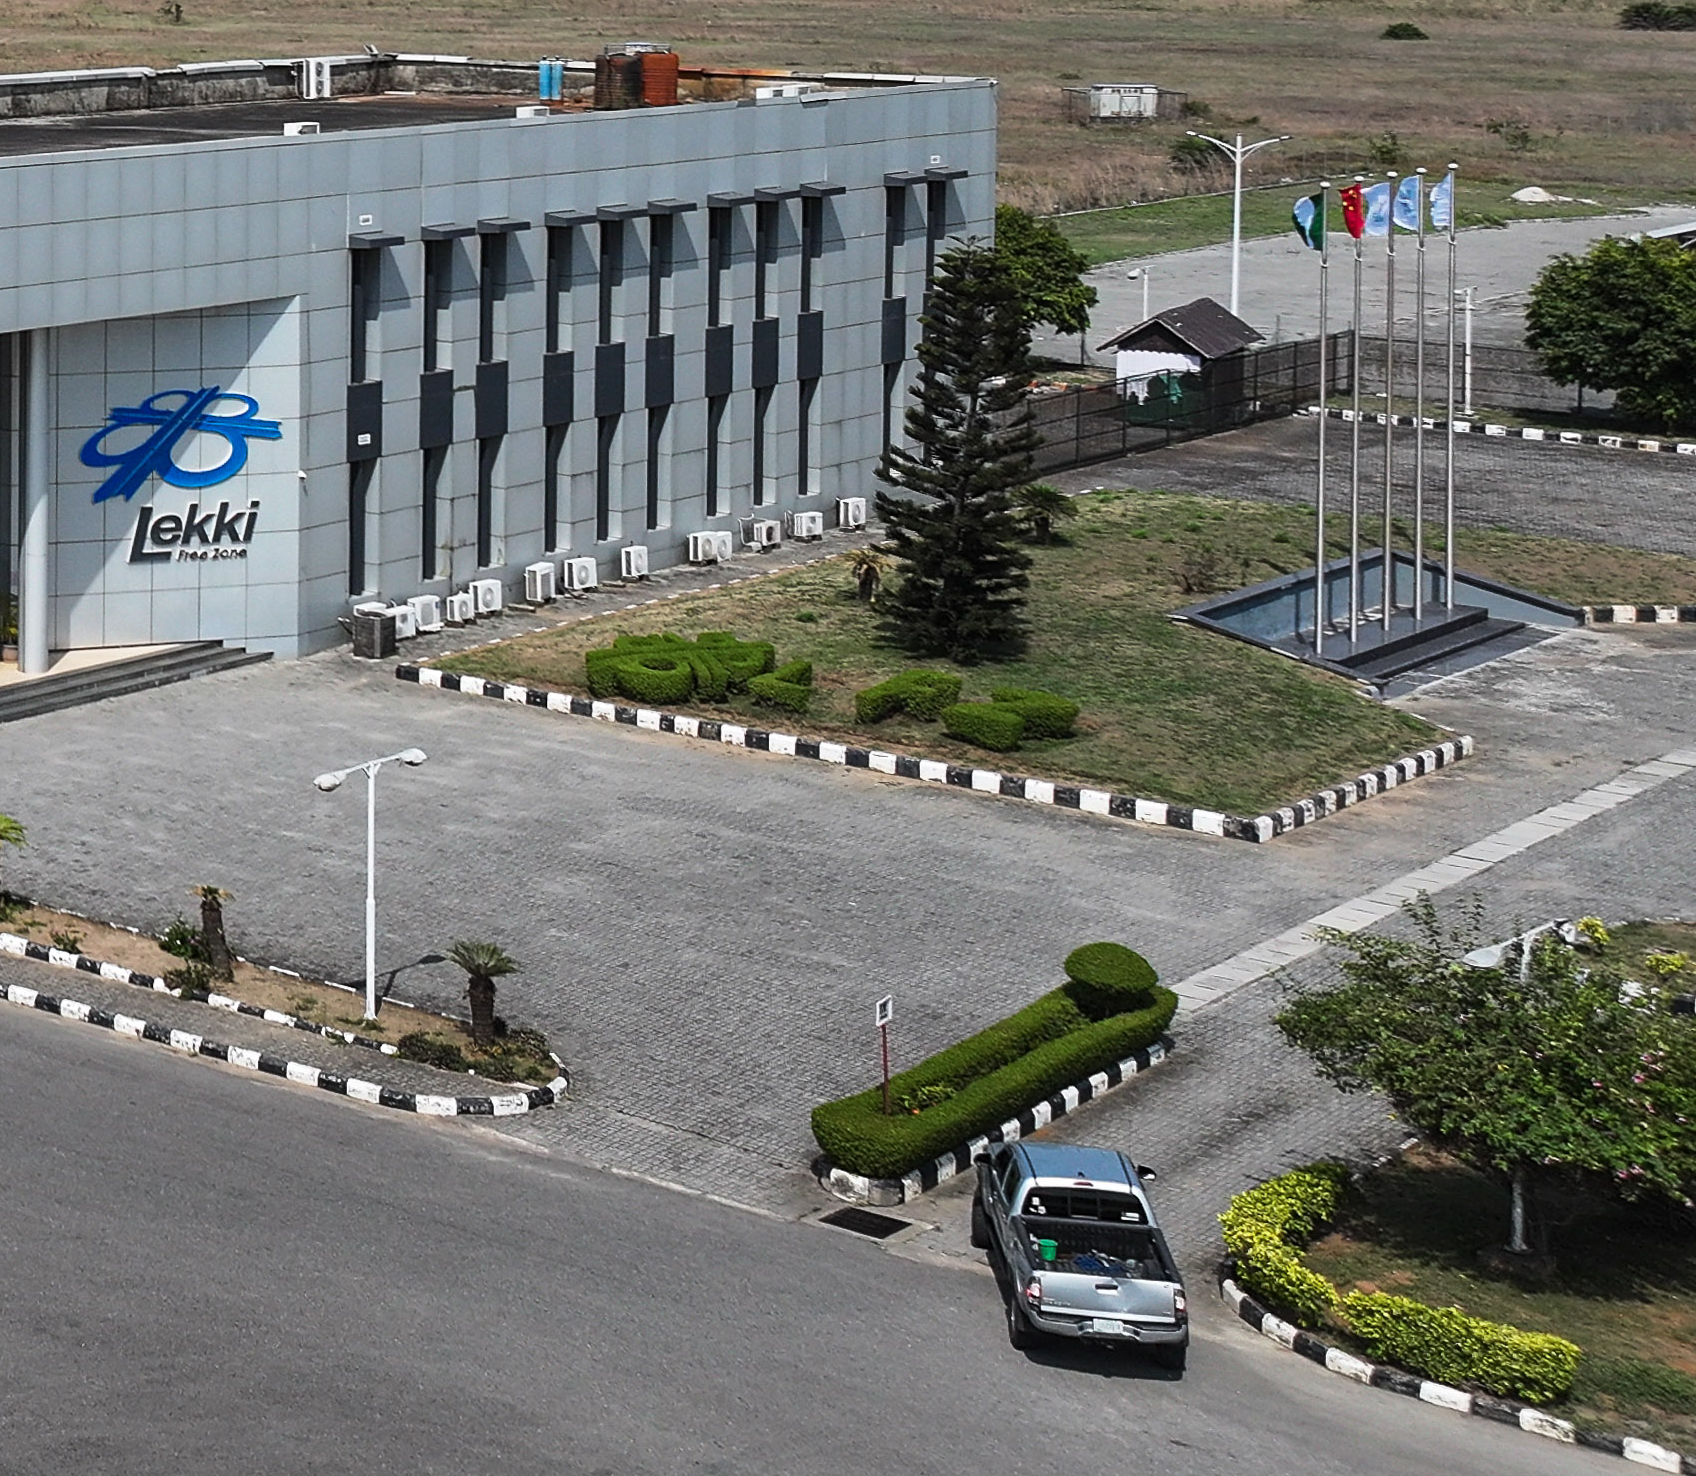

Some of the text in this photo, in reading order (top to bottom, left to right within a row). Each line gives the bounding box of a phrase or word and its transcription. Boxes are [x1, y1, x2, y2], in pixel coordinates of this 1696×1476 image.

[128, 500, 260, 563] Lekki
[177, 548, 247, 562] Free Zone
